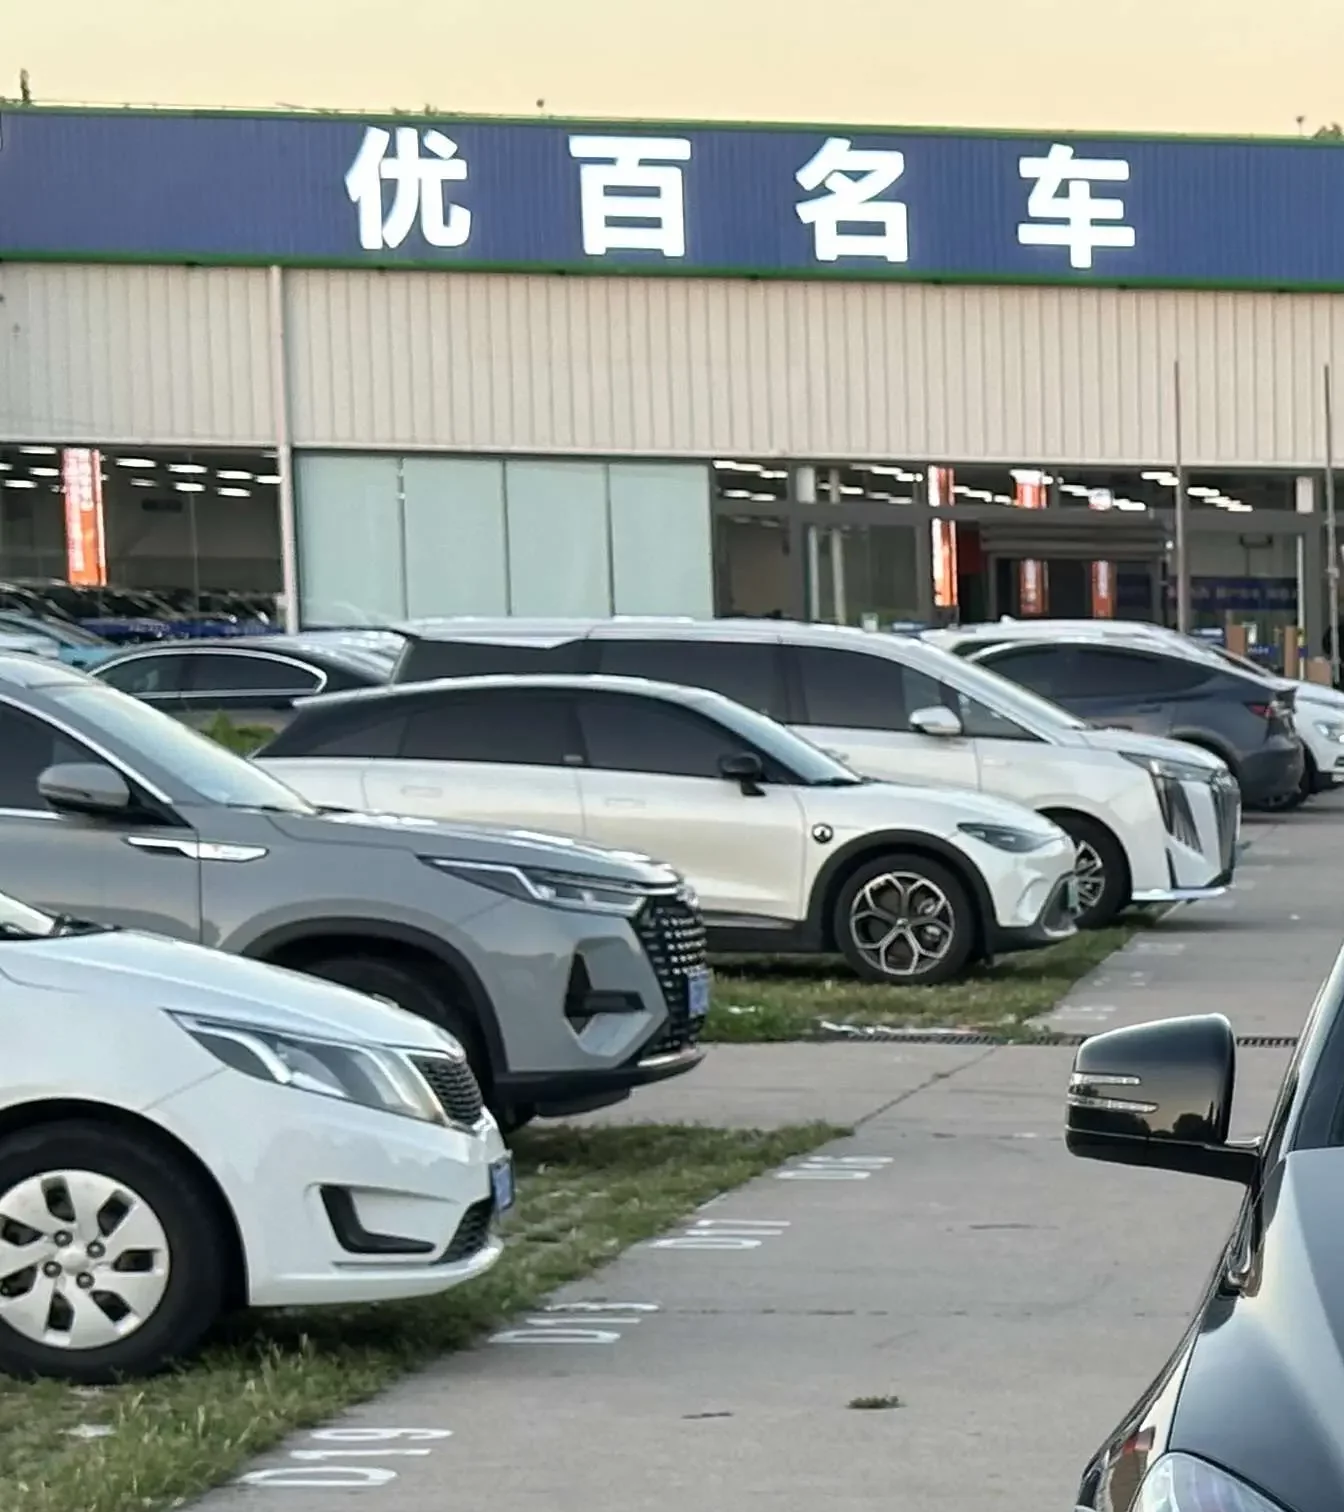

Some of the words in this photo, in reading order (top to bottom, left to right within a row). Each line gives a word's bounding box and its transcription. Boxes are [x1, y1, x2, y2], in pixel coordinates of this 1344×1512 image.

[345, 125, 1135, 268] 优百名车
[652, 1219, 791, 1250] D17
[237, 1426, 454, 1488] D19
